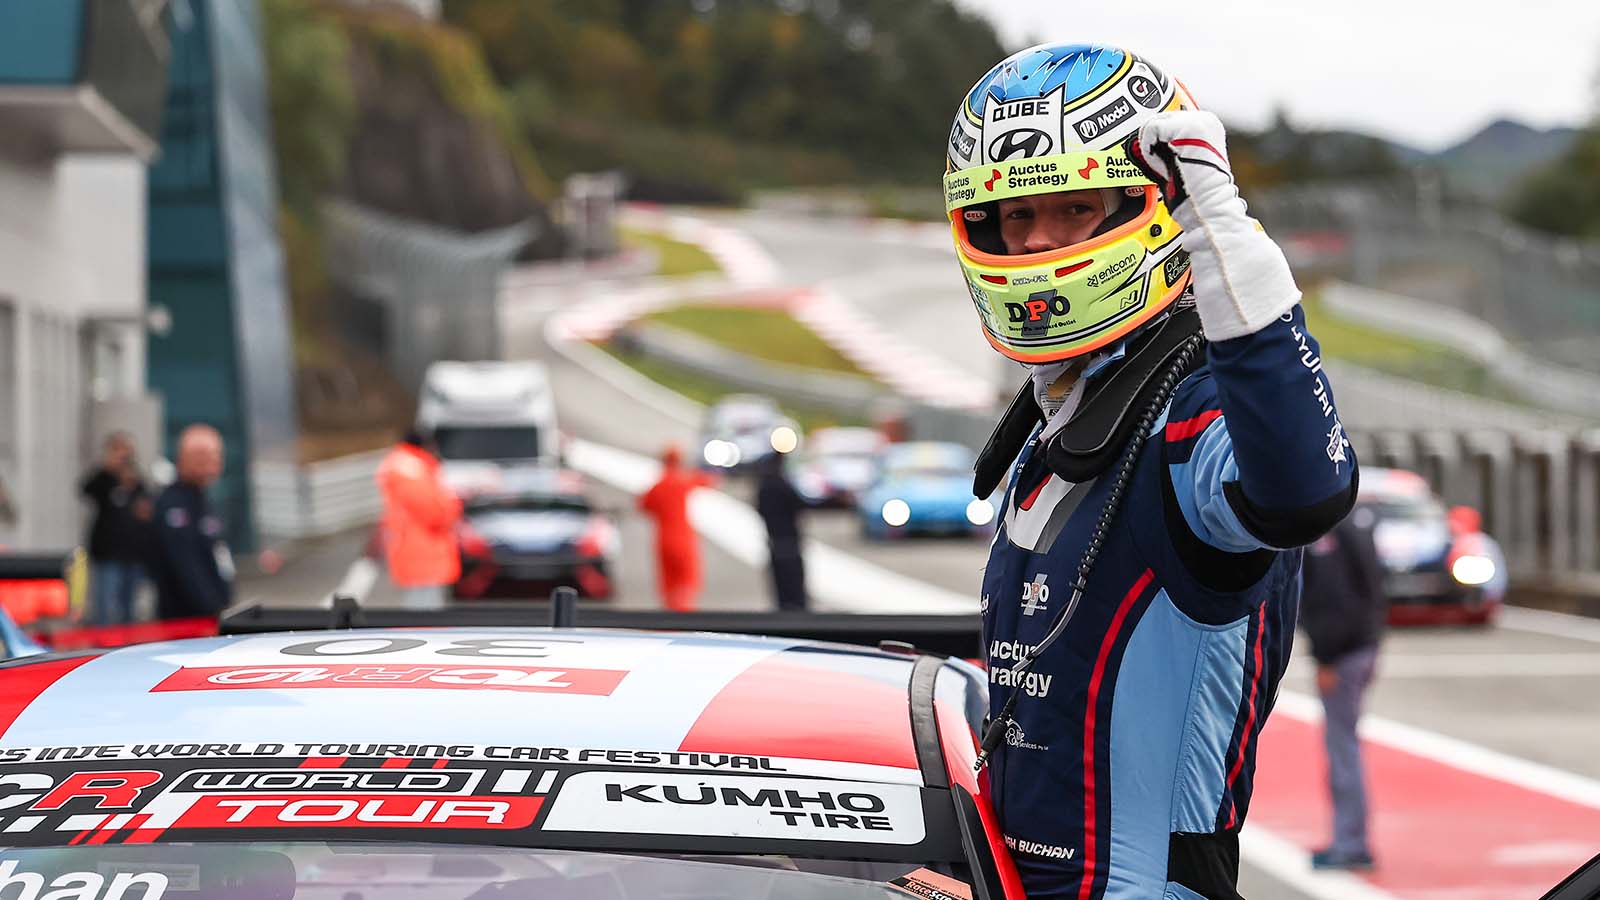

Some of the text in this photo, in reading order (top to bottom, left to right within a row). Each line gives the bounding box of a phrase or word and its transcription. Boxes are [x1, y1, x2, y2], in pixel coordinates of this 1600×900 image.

[992, 101, 1050, 122] QUBE
[1007, 162, 1058, 176] Auctus
[1105, 156, 1131, 167] Auc
[1106, 166, 1144, 178] Strate
[1008, 172, 1069, 189] Strategy
[1004, 295, 1071, 323] DPO
[1022, 582, 1050, 603] DPO
[990, 666, 1052, 698] rategy
[35, 745, 124, 760] INJE
[131, 743, 284, 758] WORLD
[298, 743, 474, 758] TOURING
[484, 746, 572, 760] CAR
[579, 749, 788, 772] FESTIVAL
[192, 773, 453, 791] WORLD
[216, 799, 511, 824] TOUR
[769, 810, 894, 832] TIRE
[1018, 839, 1075, 860] BUCHAN
